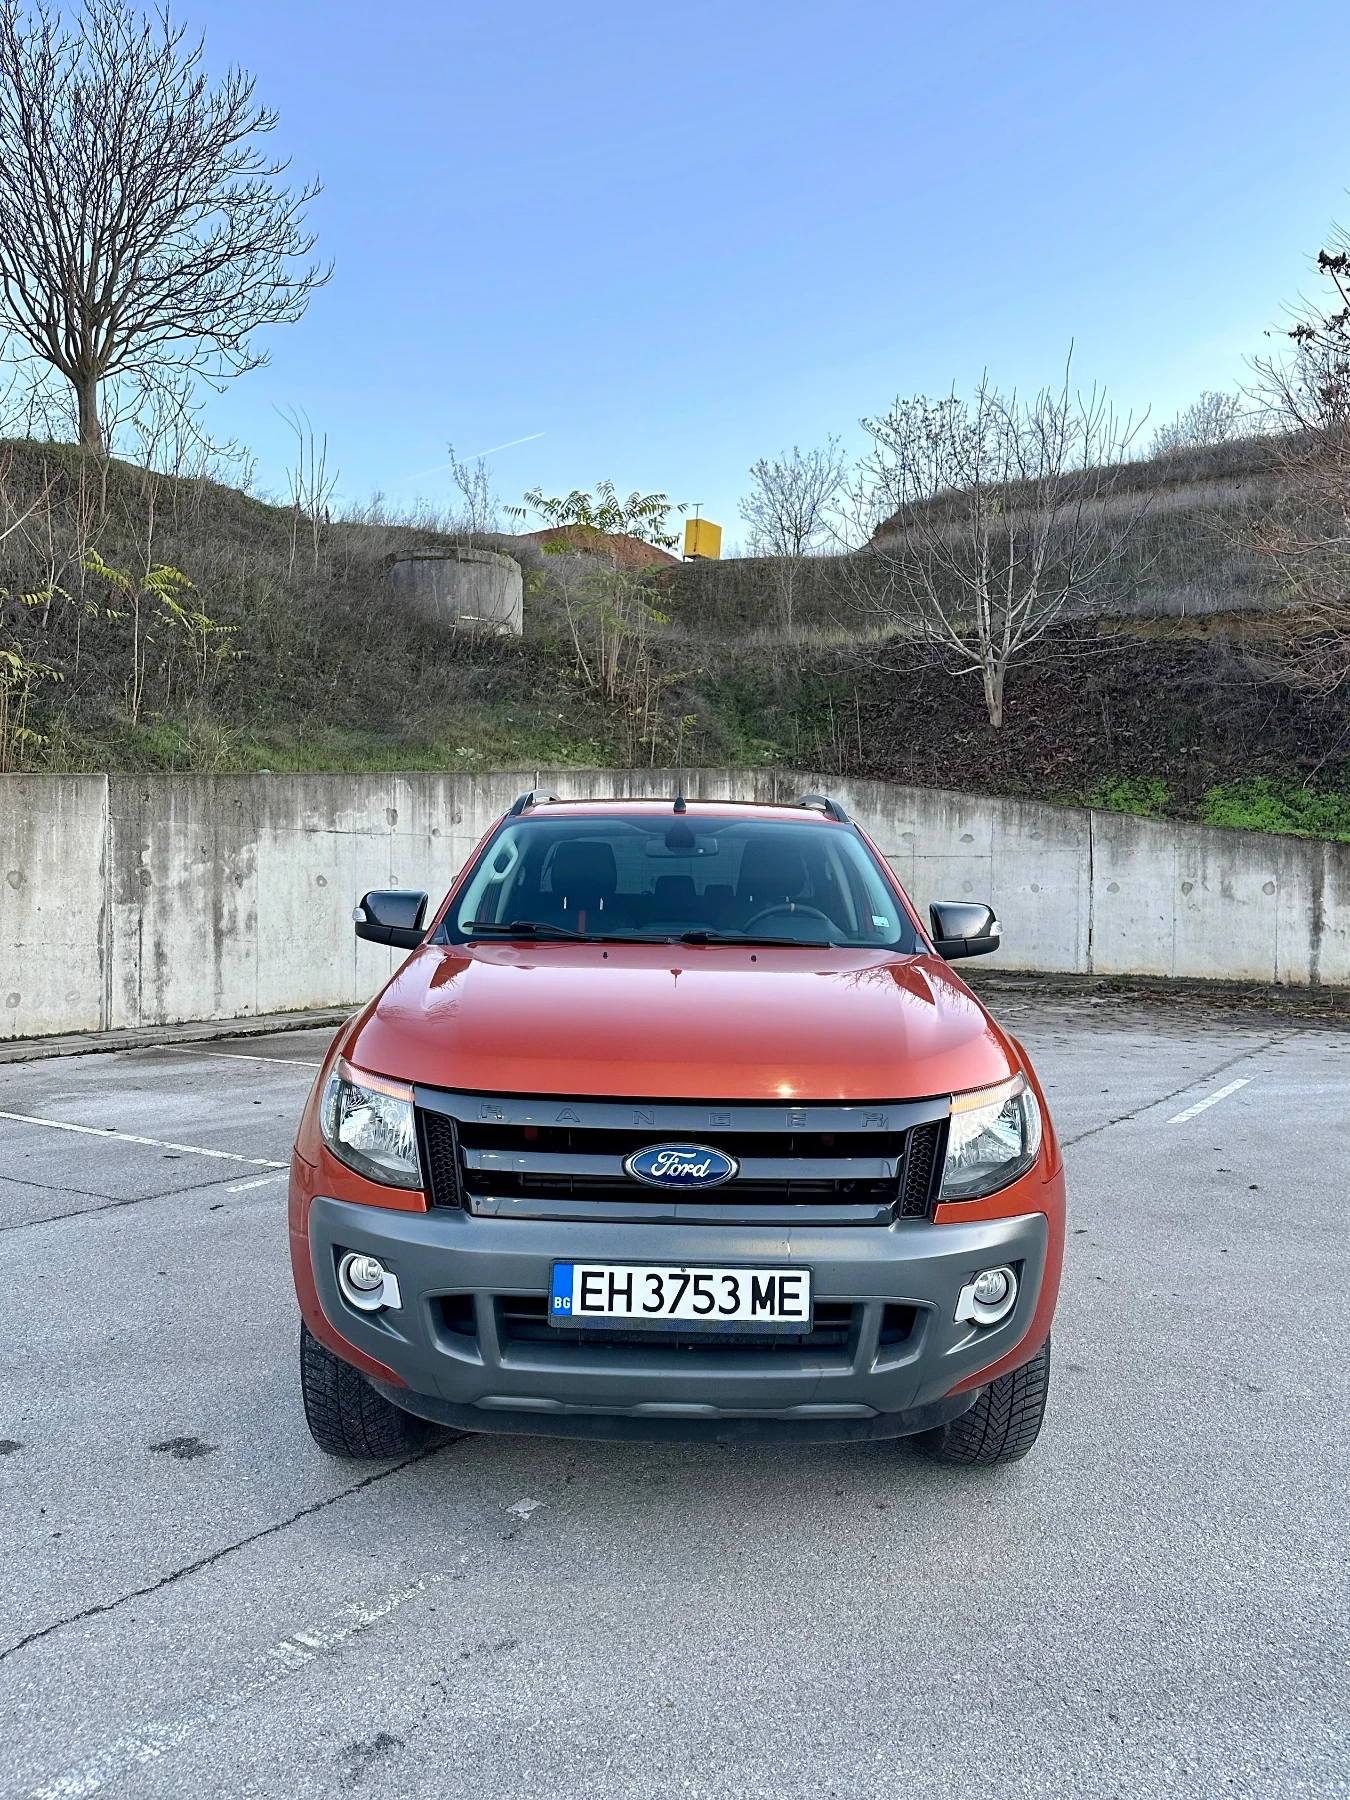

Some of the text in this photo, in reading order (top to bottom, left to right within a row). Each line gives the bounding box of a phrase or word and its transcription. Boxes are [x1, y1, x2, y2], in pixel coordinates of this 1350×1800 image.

[480, 1104, 886, 1128] RANGER
[651, 1151, 711, 1177] Ford
[554, 1296, 571, 1309] BG
[580, 1271, 803, 1316] EH 3753 ME
